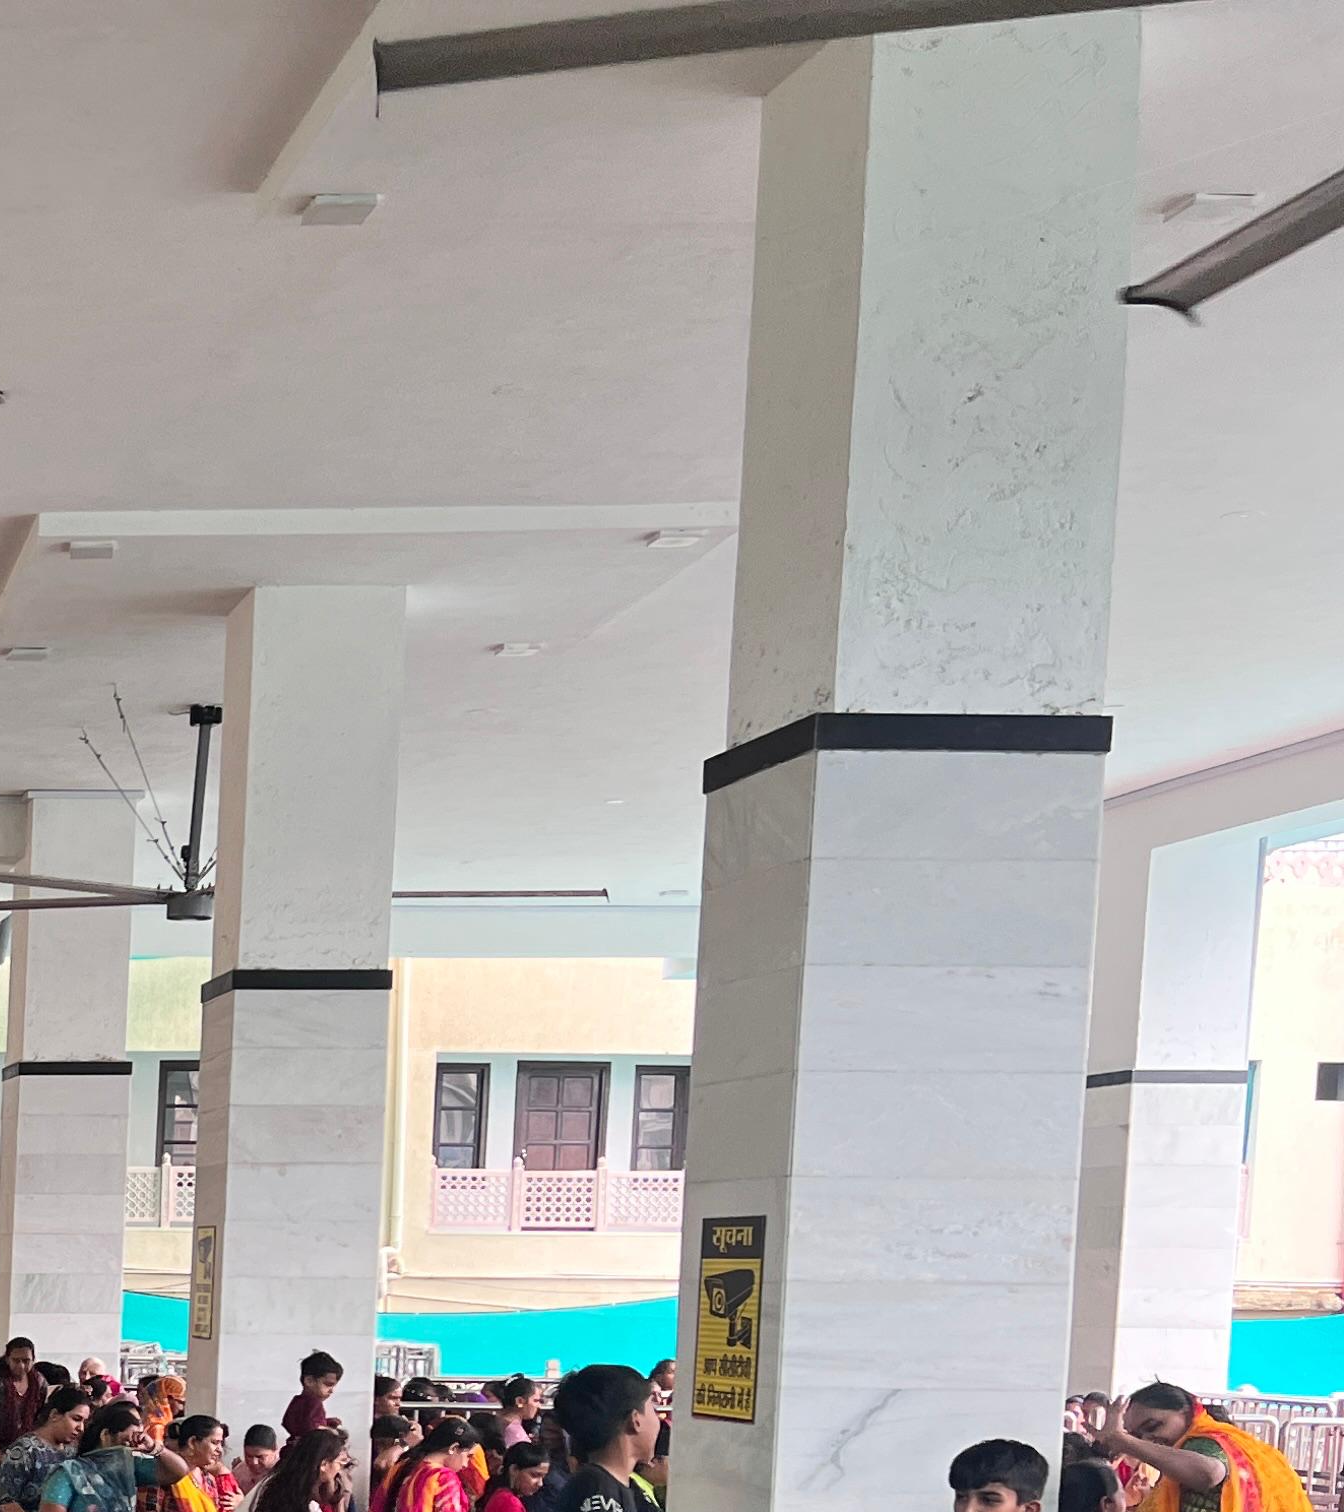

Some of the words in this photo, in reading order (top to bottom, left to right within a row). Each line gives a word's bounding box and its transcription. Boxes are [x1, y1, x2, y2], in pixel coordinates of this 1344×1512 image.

[712, 1226, 753, 1254] सूचना
[703, 1357, 717, 1376] आप
[719, 1353, 752, 1378] सीसीटीवी
[696, 1383, 706, 1405] की
[707, 1383, 736, 1409] निगरानी
